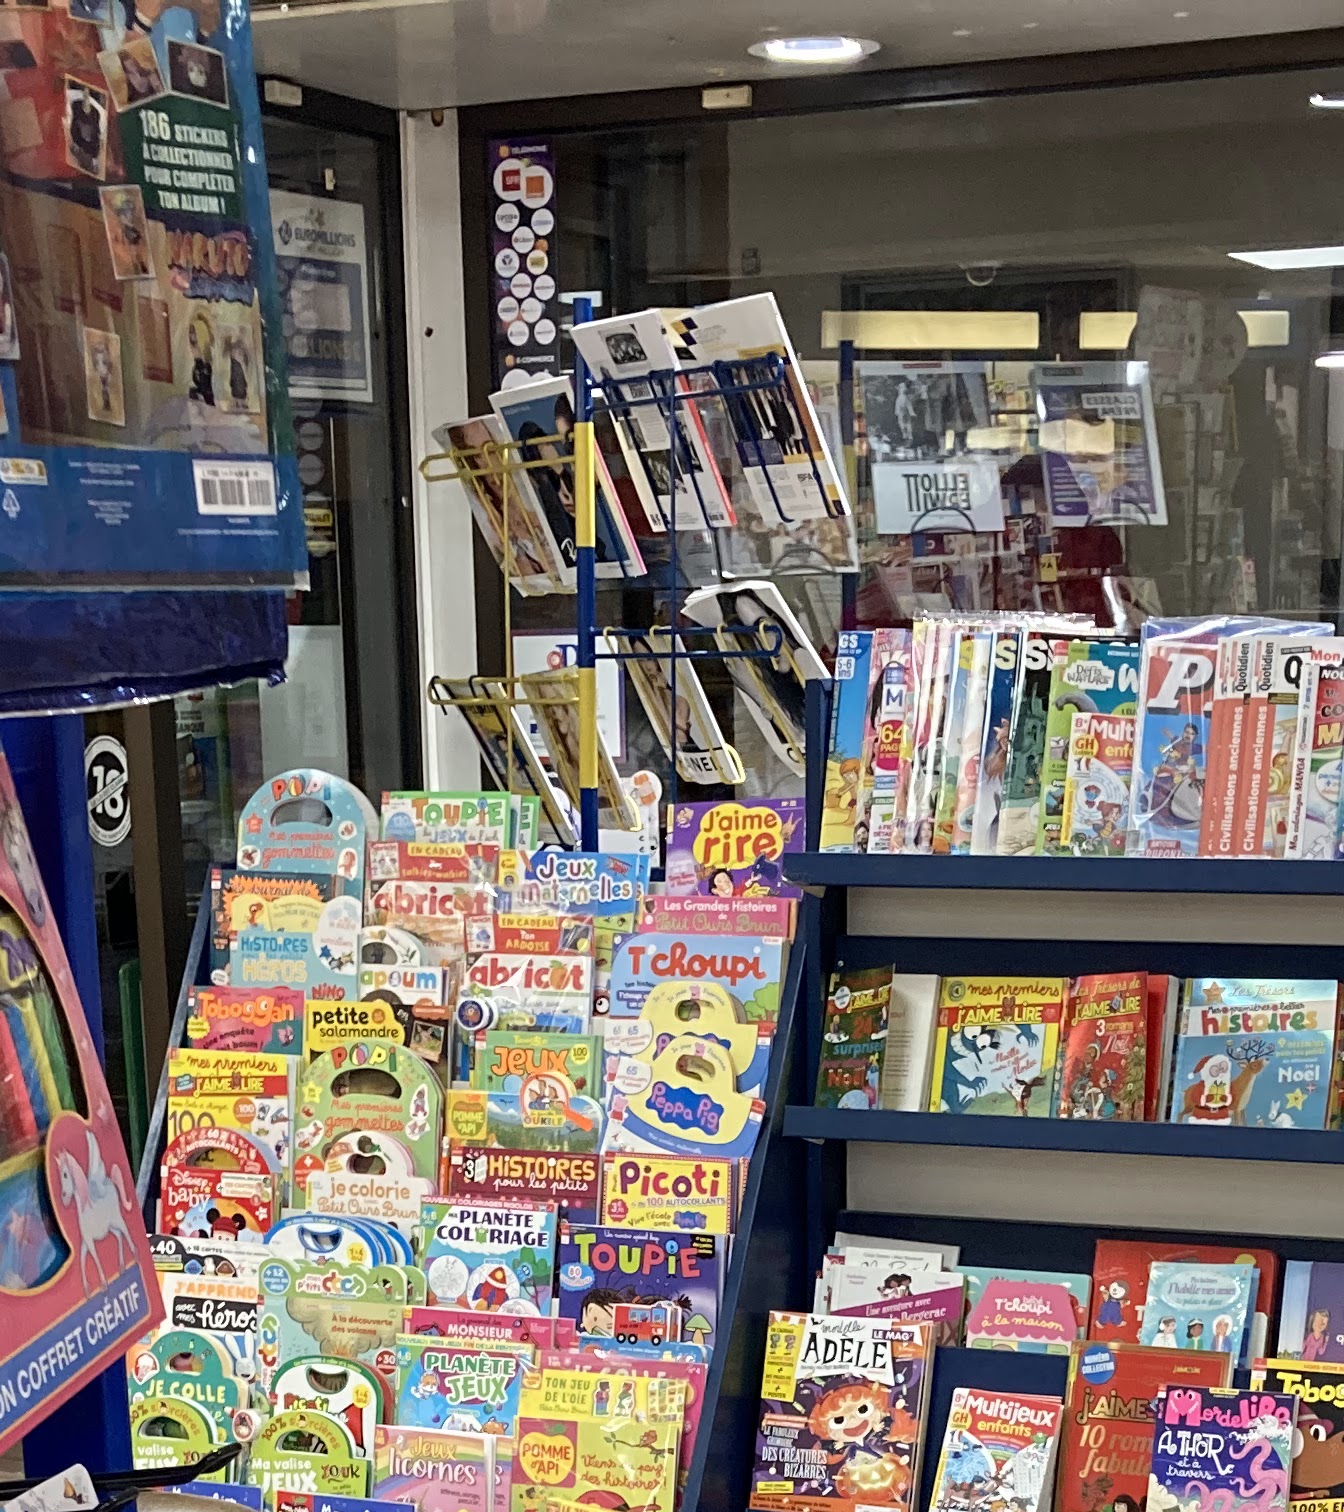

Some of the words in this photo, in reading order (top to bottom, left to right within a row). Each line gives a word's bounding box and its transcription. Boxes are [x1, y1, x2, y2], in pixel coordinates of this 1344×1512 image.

[139, 109, 170, 141] 186
[174, 124, 228, 148] STICKERS
[1259, 641, 1275, 692] Quotidien
[272, 776, 332, 801] POPI
[412, 797, 504, 829] TOUPIE
[704, 809, 778, 833] J'aime
[703, 832, 777, 864] rire
[539, 855, 598, 882] Jeux
[373, 882, 489, 917] abricot
[516, 876, 632, 906] maternelles
[683, 901, 729, 914] Grandes
[732, 901, 777, 913] Histoires
[241, 937, 309, 954] HISTOIRES
[361, 970, 437, 991] apoum
[469, 958, 584, 990] abricot
[199, 993, 295, 1027] Toboggan
[312, 1007, 369, 1027] petite
[1201, 1007, 1318, 1038] histoires
[319, 1025, 399, 1041] salamandre
[212, 1056, 277, 1077] premiers
[331, 1044, 397, 1070] POPI
[492, 1047, 570, 1076] JEUX
[650, 1081, 693, 1122] Peppa
[489, 1156, 596, 1180] HISTOIRES
[619, 1160, 721, 1198] Picoti
[167, 1184, 210, 1212] baby
[329, 1177, 346, 1198] je
[348, 1181, 410, 1200] colorie
[459, 1209, 534, 1229] PLANÈTE
[574, 1233, 701, 1278] TOUPIE
[996, 1297, 1053, 1316] T'choupi
[447, 1323, 513, 1339] MONSIEUR
[1011, 1314, 1066, 1333] maison
[17, 1336, 85, 1408] COFFRET
[83, 1282, 142, 1363] CRÉATIF
[800, 1331, 889, 1370] ADÈLE
[425, 1350, 517, 1377] PLANÈTE
[169, 1381, 227, 1404] COLLE
[446, 1374, 508, 1405] JEUX
[966, 1394, 1055, 1429] Multijeux
[976, 1419, 1033, 1438] enfants
[408, 1436, 458, 1461] Jeux
[521, 1442, 572, 1460] POMME
[779, 1447, 828, 1465] CRÉATURES
[272, 1457, 312, 1471] valise
[388, 1446, 478, 1486] licornes
[783, 1466, 828, 1479] BIZARRES
[257, 1471, 319, 1494] JEUX
